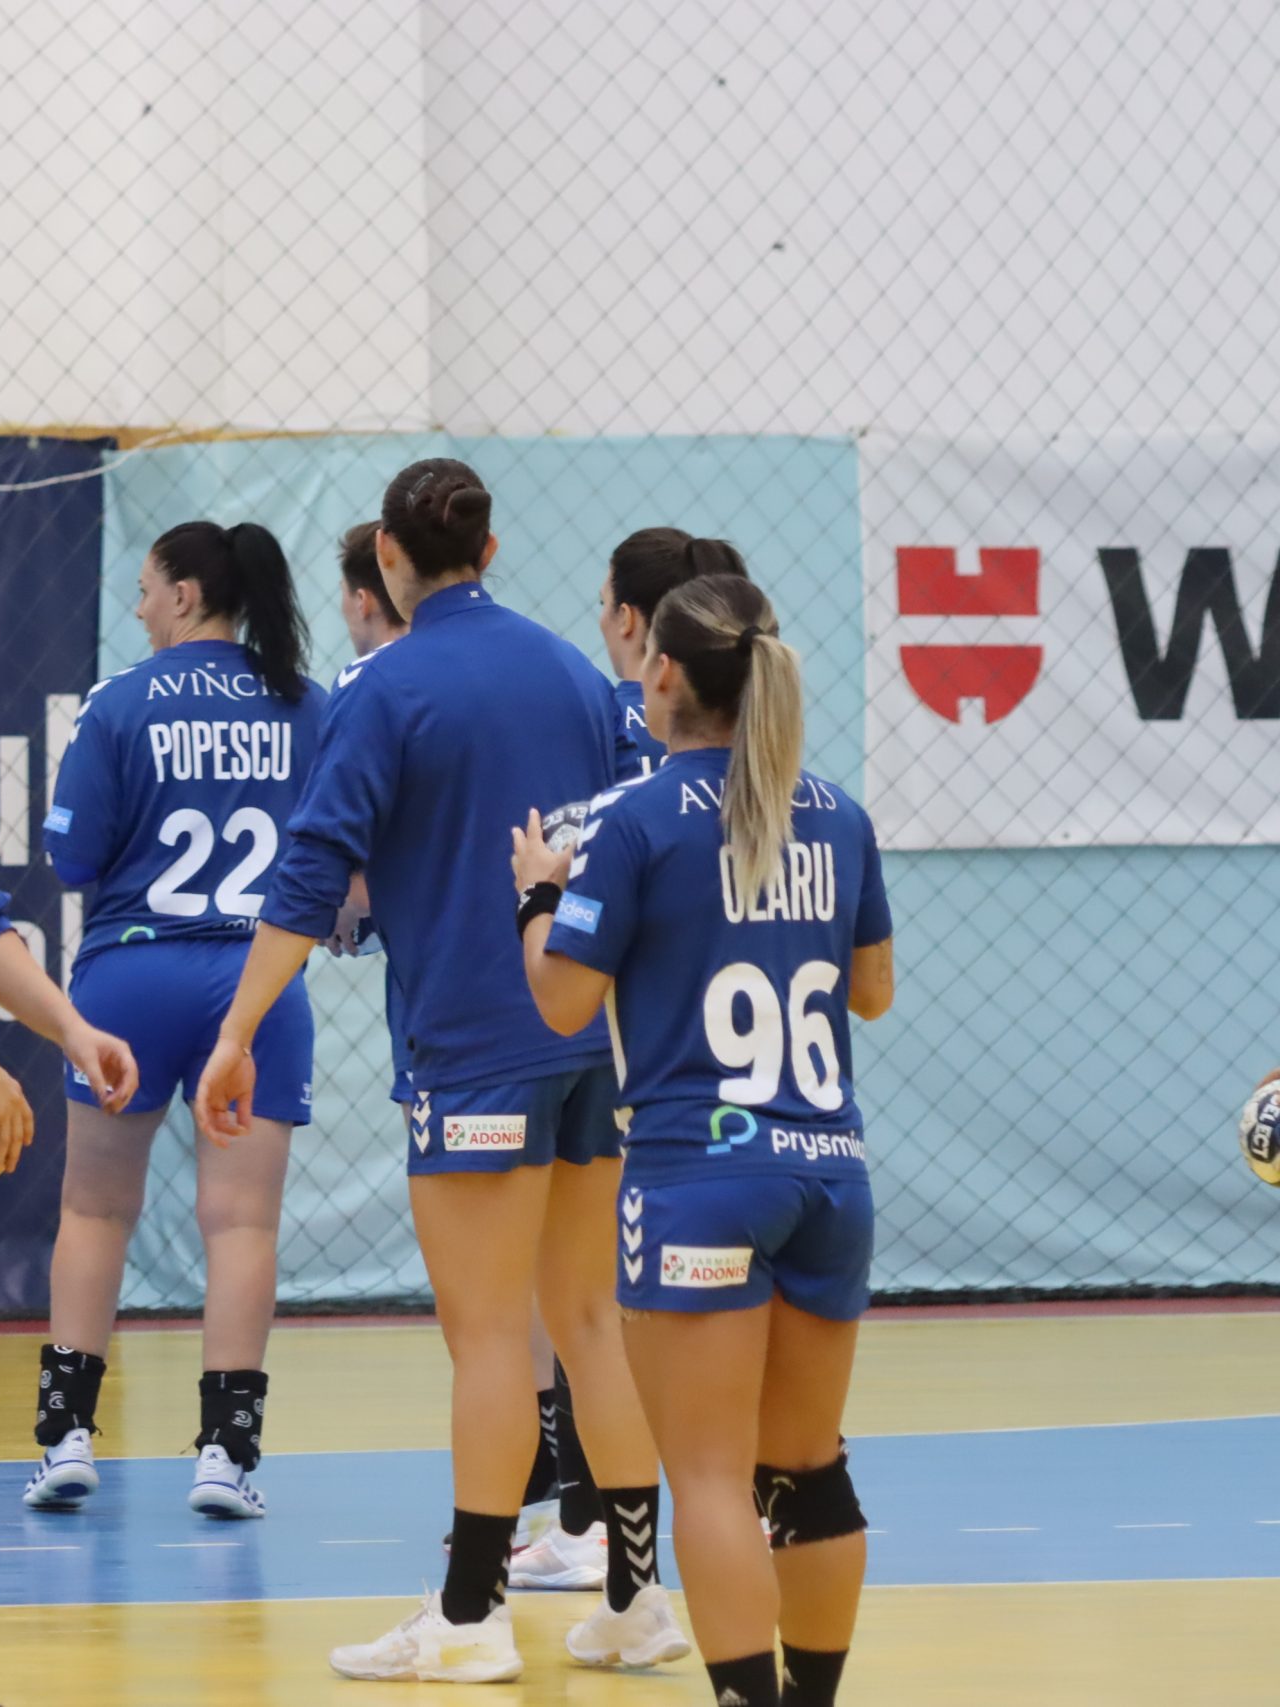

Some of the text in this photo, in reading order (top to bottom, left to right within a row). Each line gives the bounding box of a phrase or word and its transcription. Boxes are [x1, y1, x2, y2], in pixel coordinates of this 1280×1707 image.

[147, 668, 283, 700] AVINCI
[149, 721, 291, 782] POPESCU
[680, 777, 837, 814] AVCIS
[147, 807, 278, 917] 22
[560, 897, 596, 922] idea
[704, 961, 844, 1111] 96
[469, 1131, 524, 1145] ADONIS
[690, 1264, 748, 1281] ADONIS
